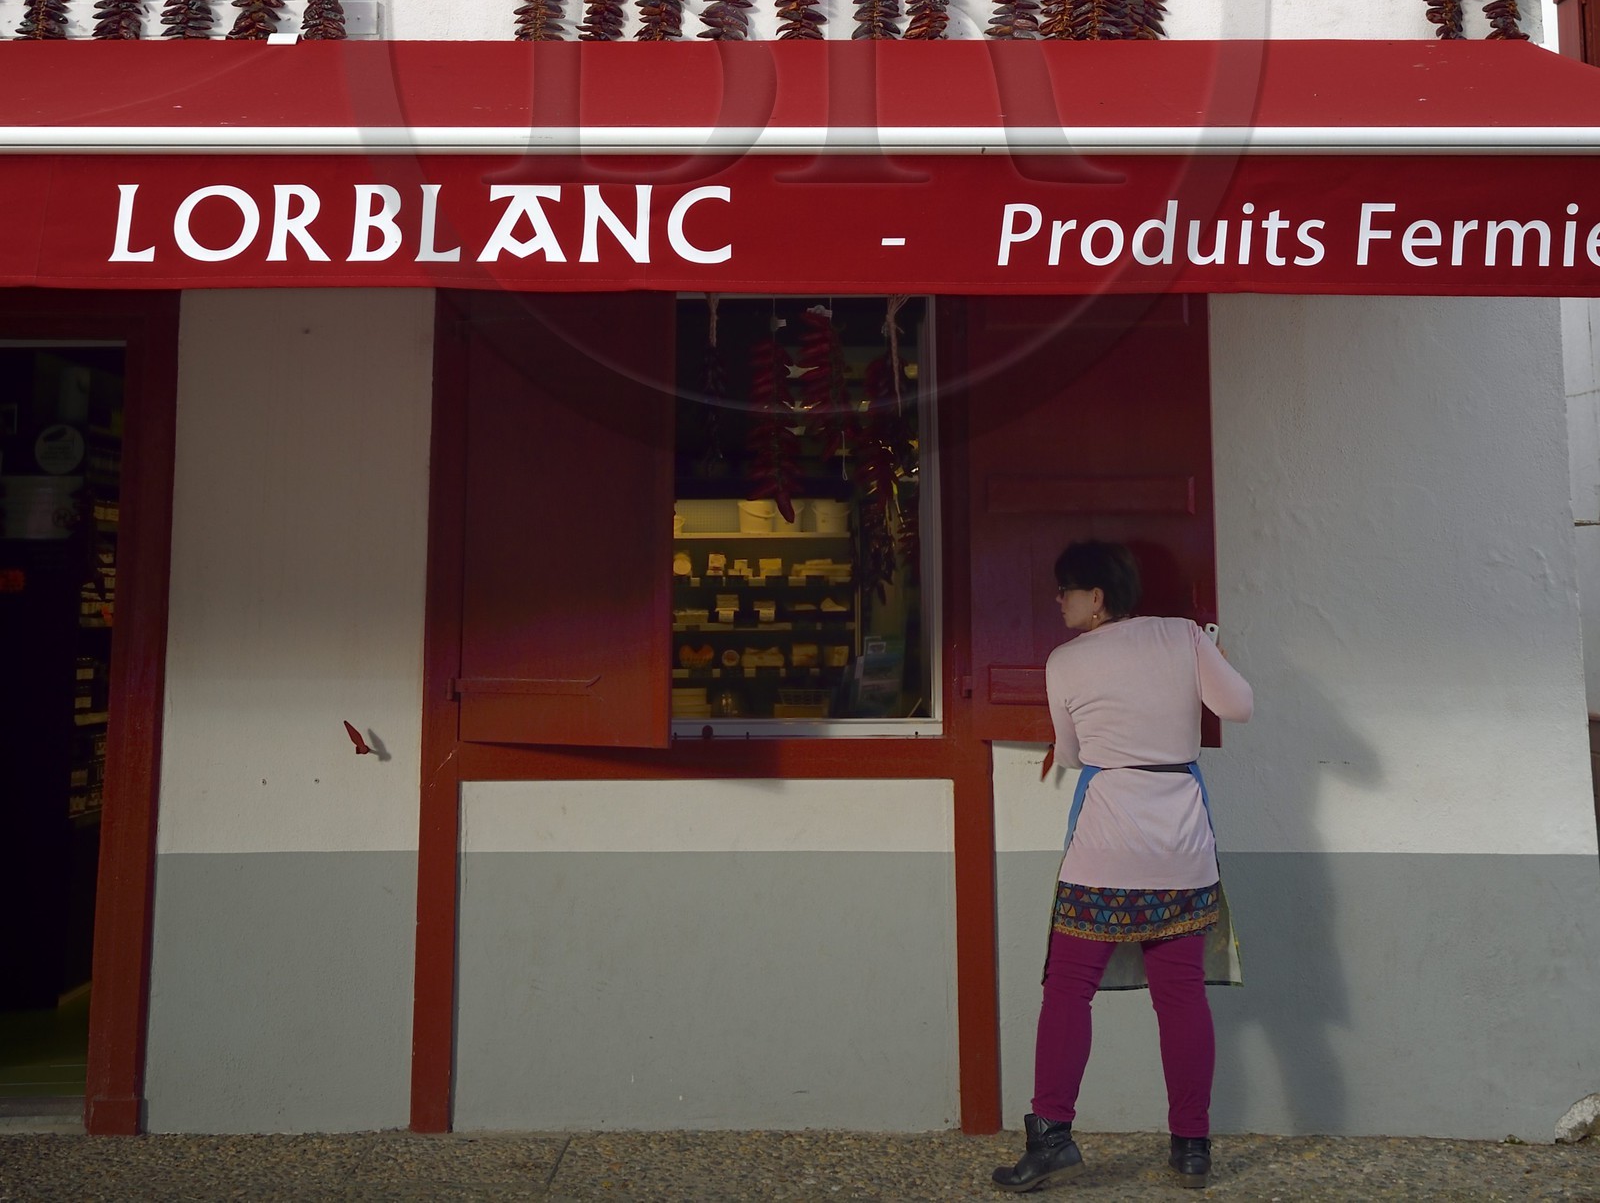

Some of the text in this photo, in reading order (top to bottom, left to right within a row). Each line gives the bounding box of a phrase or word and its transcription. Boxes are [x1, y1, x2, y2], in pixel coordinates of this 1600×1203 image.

[107, 184, 732, 264] LORBLANC
[881, 237, 906, 246] -
[997, 199, 1326, 267] Produits
